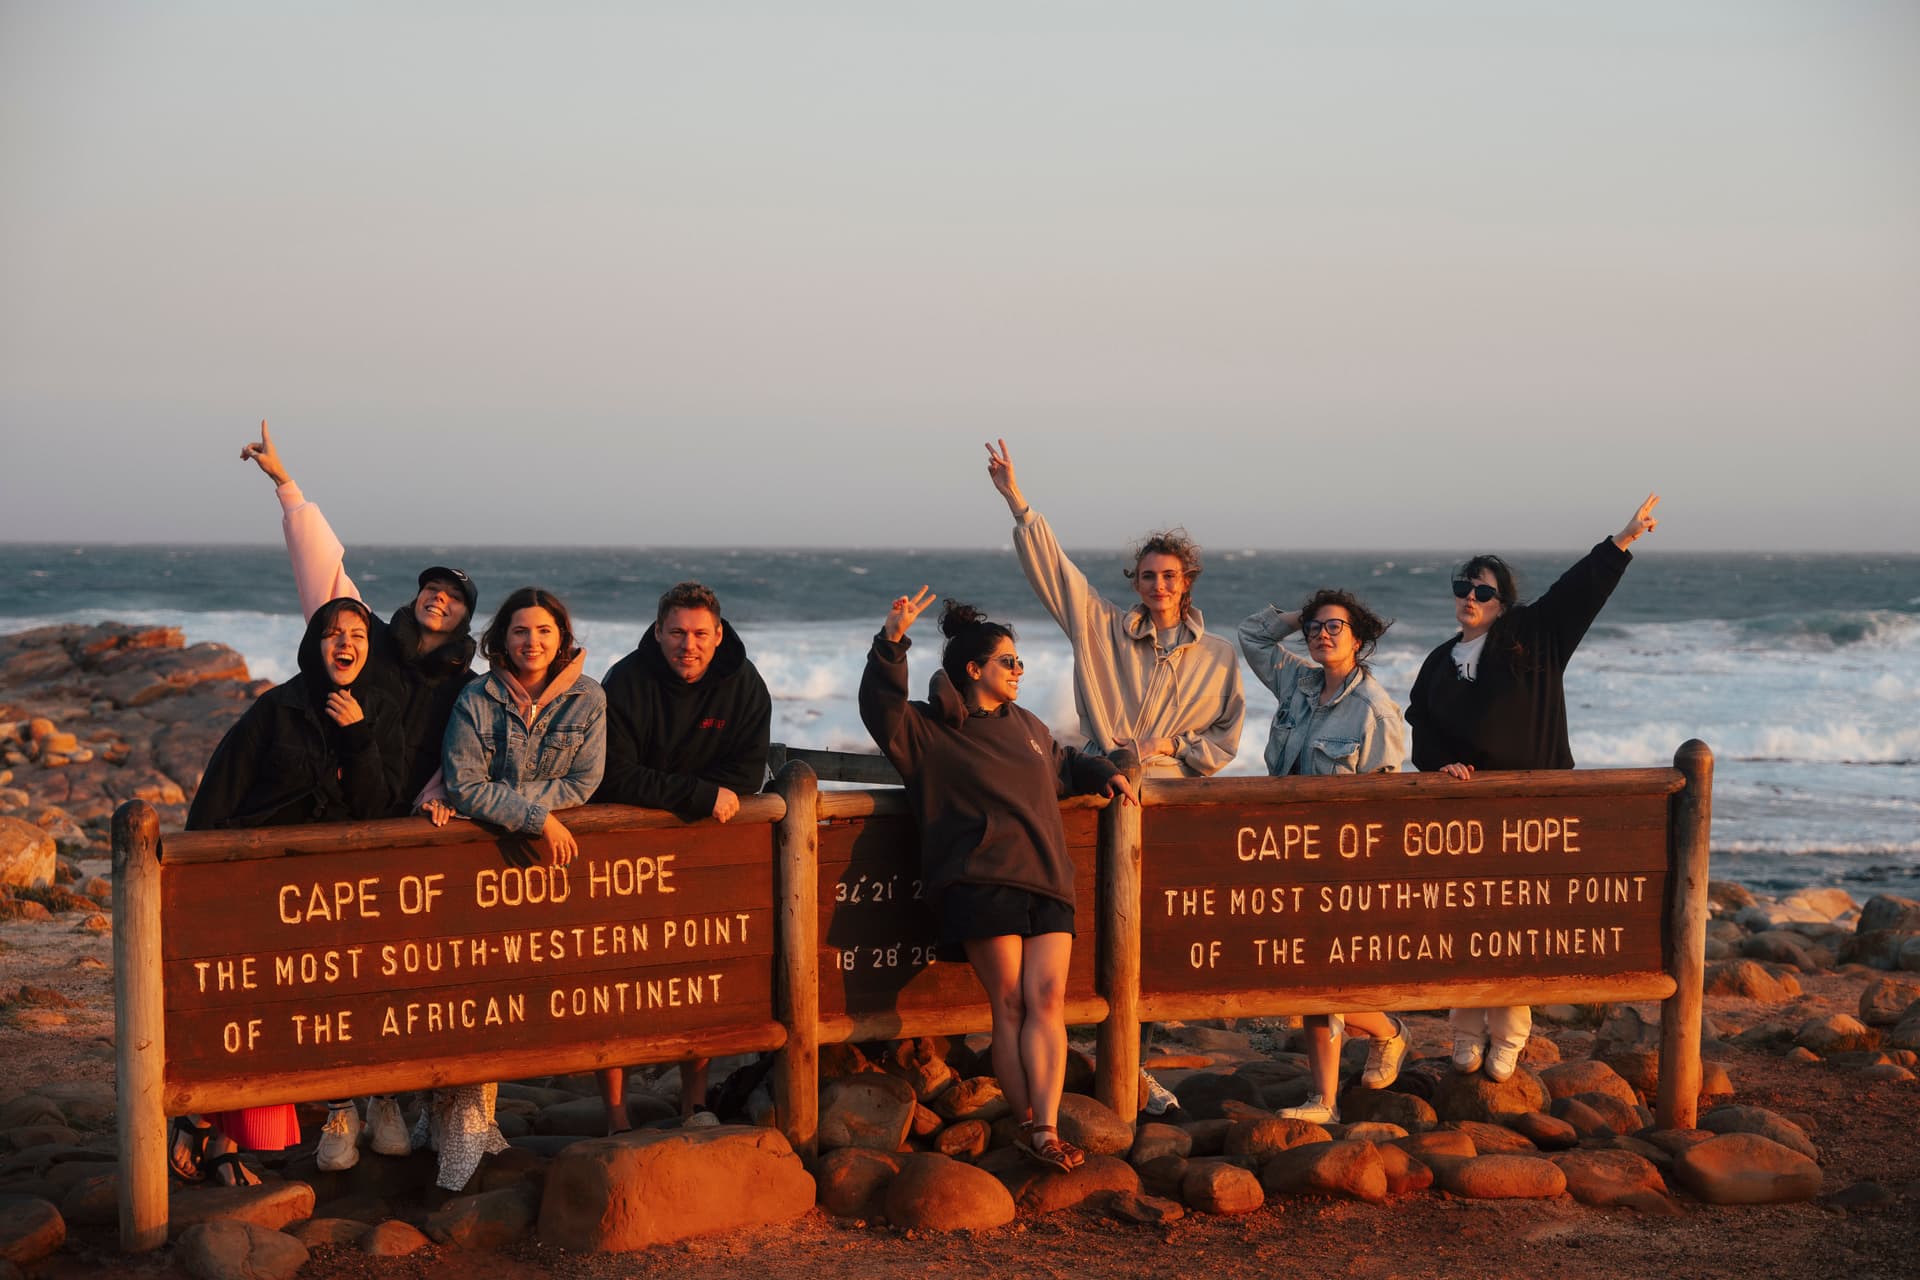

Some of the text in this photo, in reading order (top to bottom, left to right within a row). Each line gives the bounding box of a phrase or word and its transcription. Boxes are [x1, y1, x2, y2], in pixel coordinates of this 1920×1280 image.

[1237, 817, 1581, 862] CAPE OF GOOD HOPE
[279, 854, 676, 925] CAPE OF GOOD HOPE
[1164, 876, 1647, 917] THE MOST SOUTH-WESTERN POINT
[193, 913, 751, 993] THE MOST SOUTH-WESTERN POINT
[1190, 927, 1624, 969] OF THE AFRICAN CONTINENT
[223, 973, 724, 1053] OF THE AFRICAN CONTINENT
